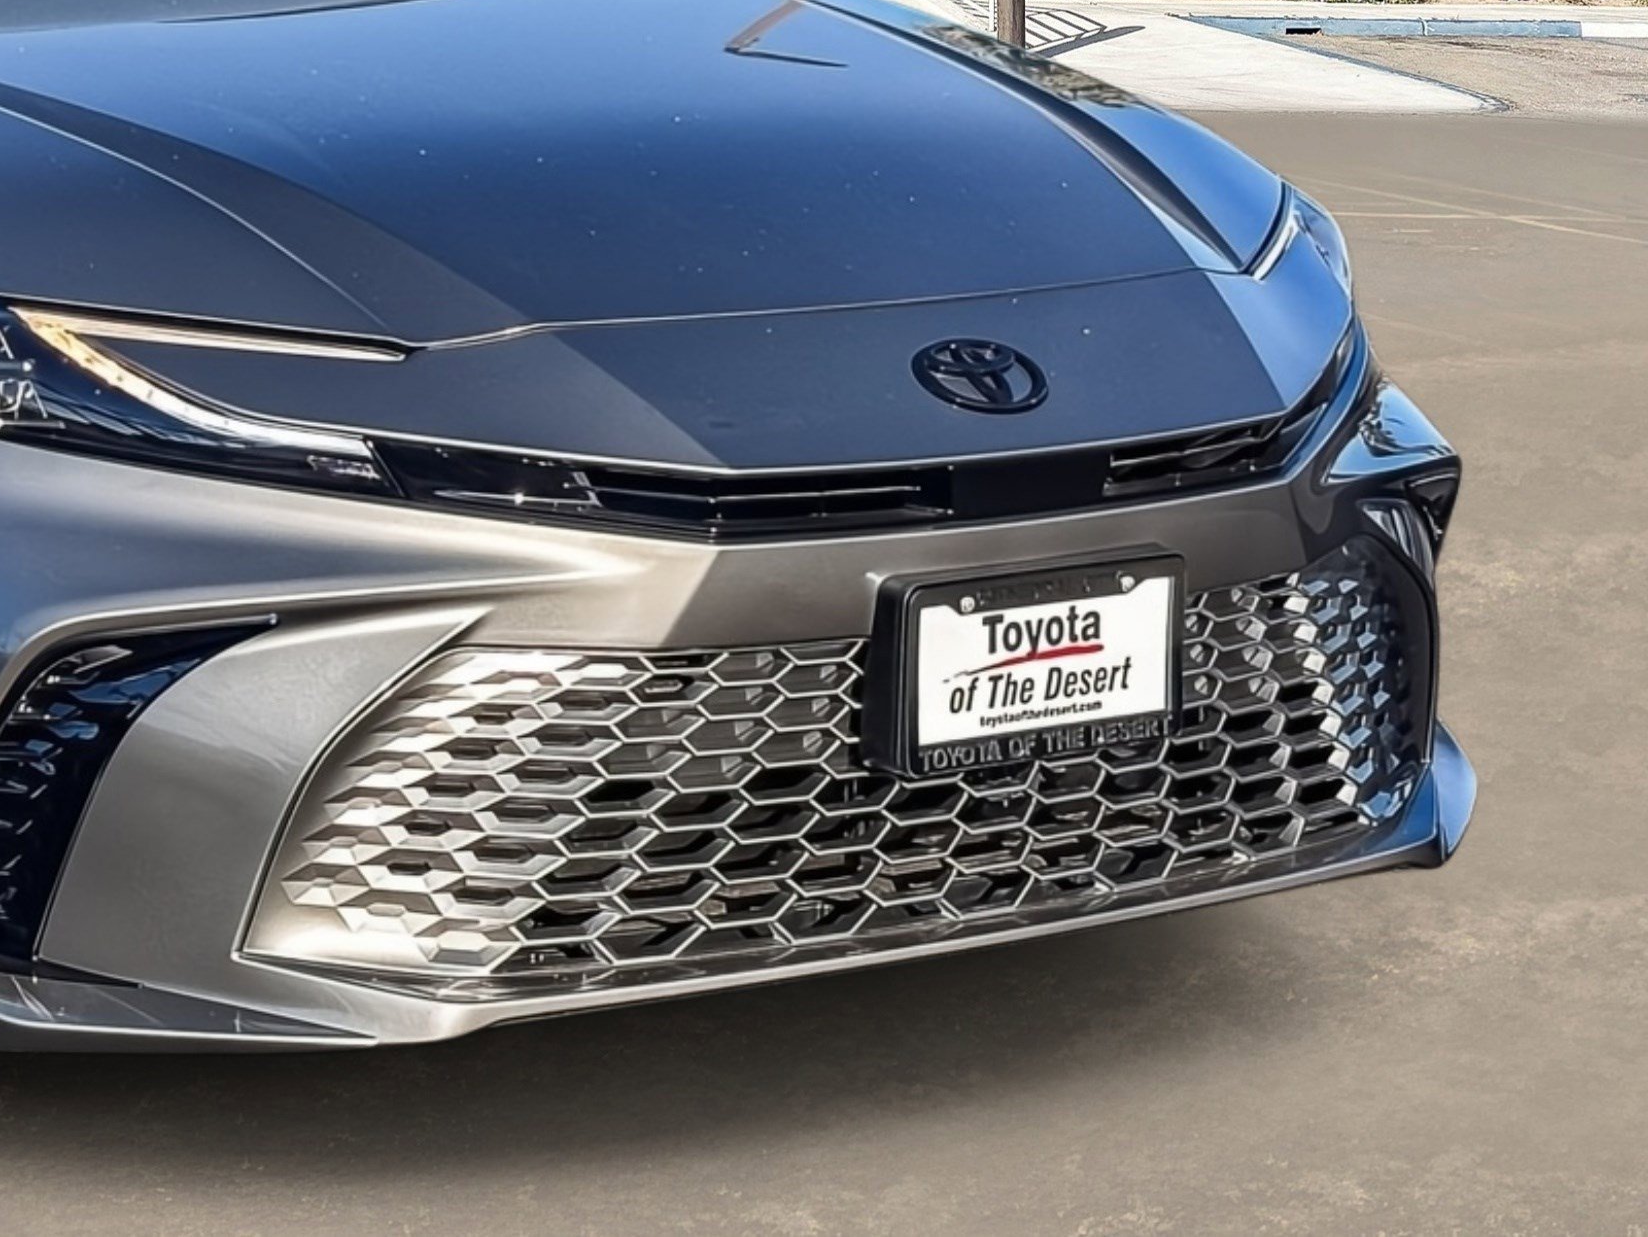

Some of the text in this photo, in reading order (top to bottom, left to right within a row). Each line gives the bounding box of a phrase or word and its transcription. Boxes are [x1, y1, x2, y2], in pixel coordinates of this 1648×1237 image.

[982, 605, 1102, 656] Toyota
[949, 656, 1132, 714] of The Desert
[920, 715, 1173, 772] TOYOTA OF THE DESERT
